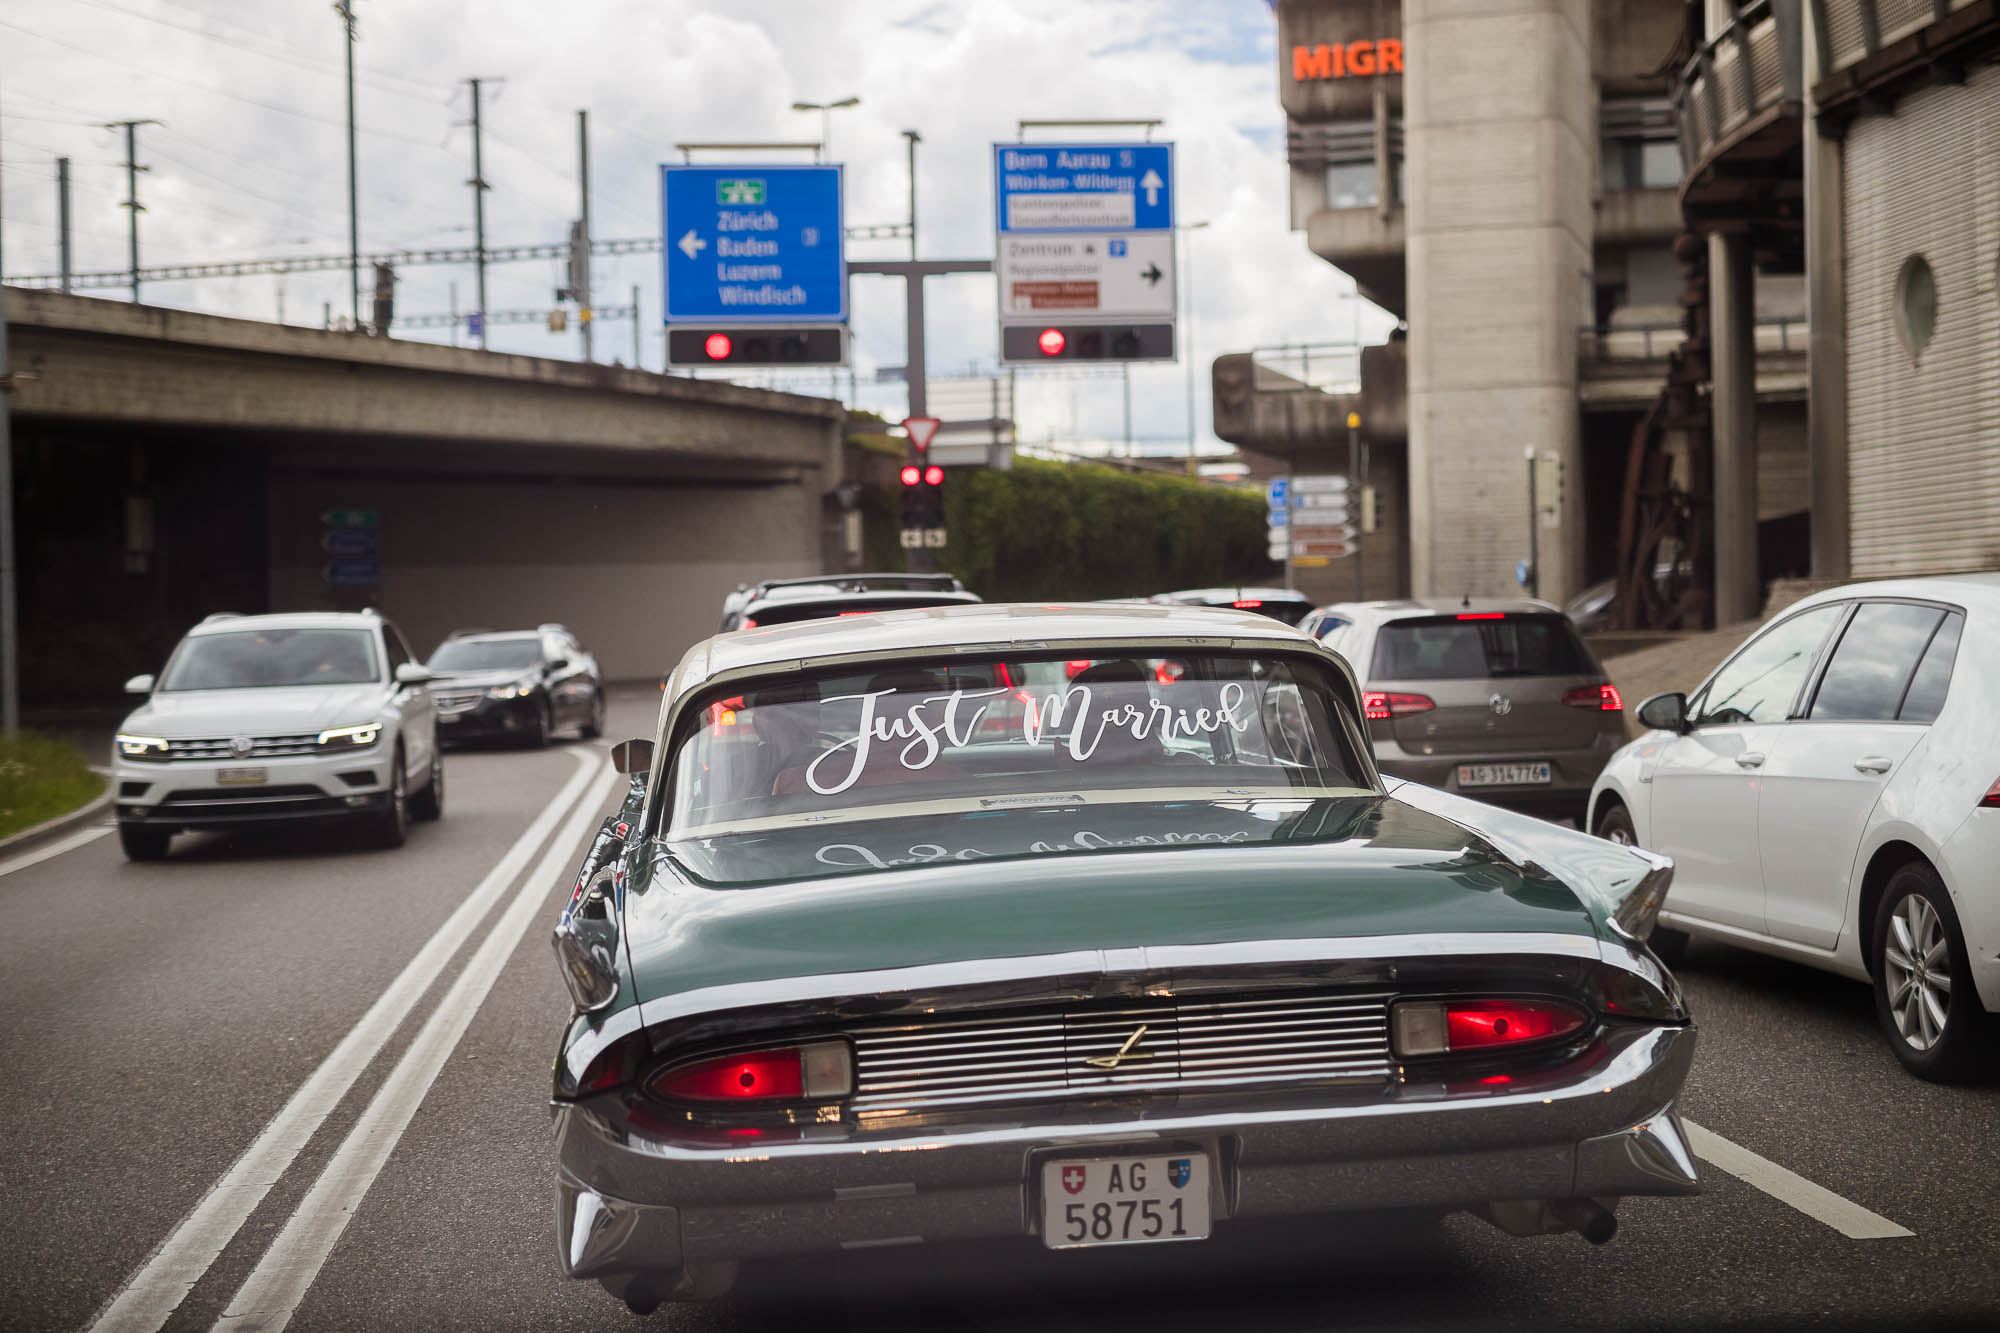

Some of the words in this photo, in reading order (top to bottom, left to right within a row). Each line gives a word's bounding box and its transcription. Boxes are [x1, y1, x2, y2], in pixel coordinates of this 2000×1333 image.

[1005, 151, 1048, 169] Bern
[1056, 151, 1110, 169] Aarau
[717, 210, 778, 231] Zürich
[717, 236, 778, 257] Baden
[717, 262, 782, 282] Luzern
[718, 286, 807, 306] Windisch
[806, 688, 1008, 795] Just
[1023, 682, 1248, 762] Married
[1108, 1162, 1146, 1193] AG
[1065, 1198, 1187, 1242] 58751
